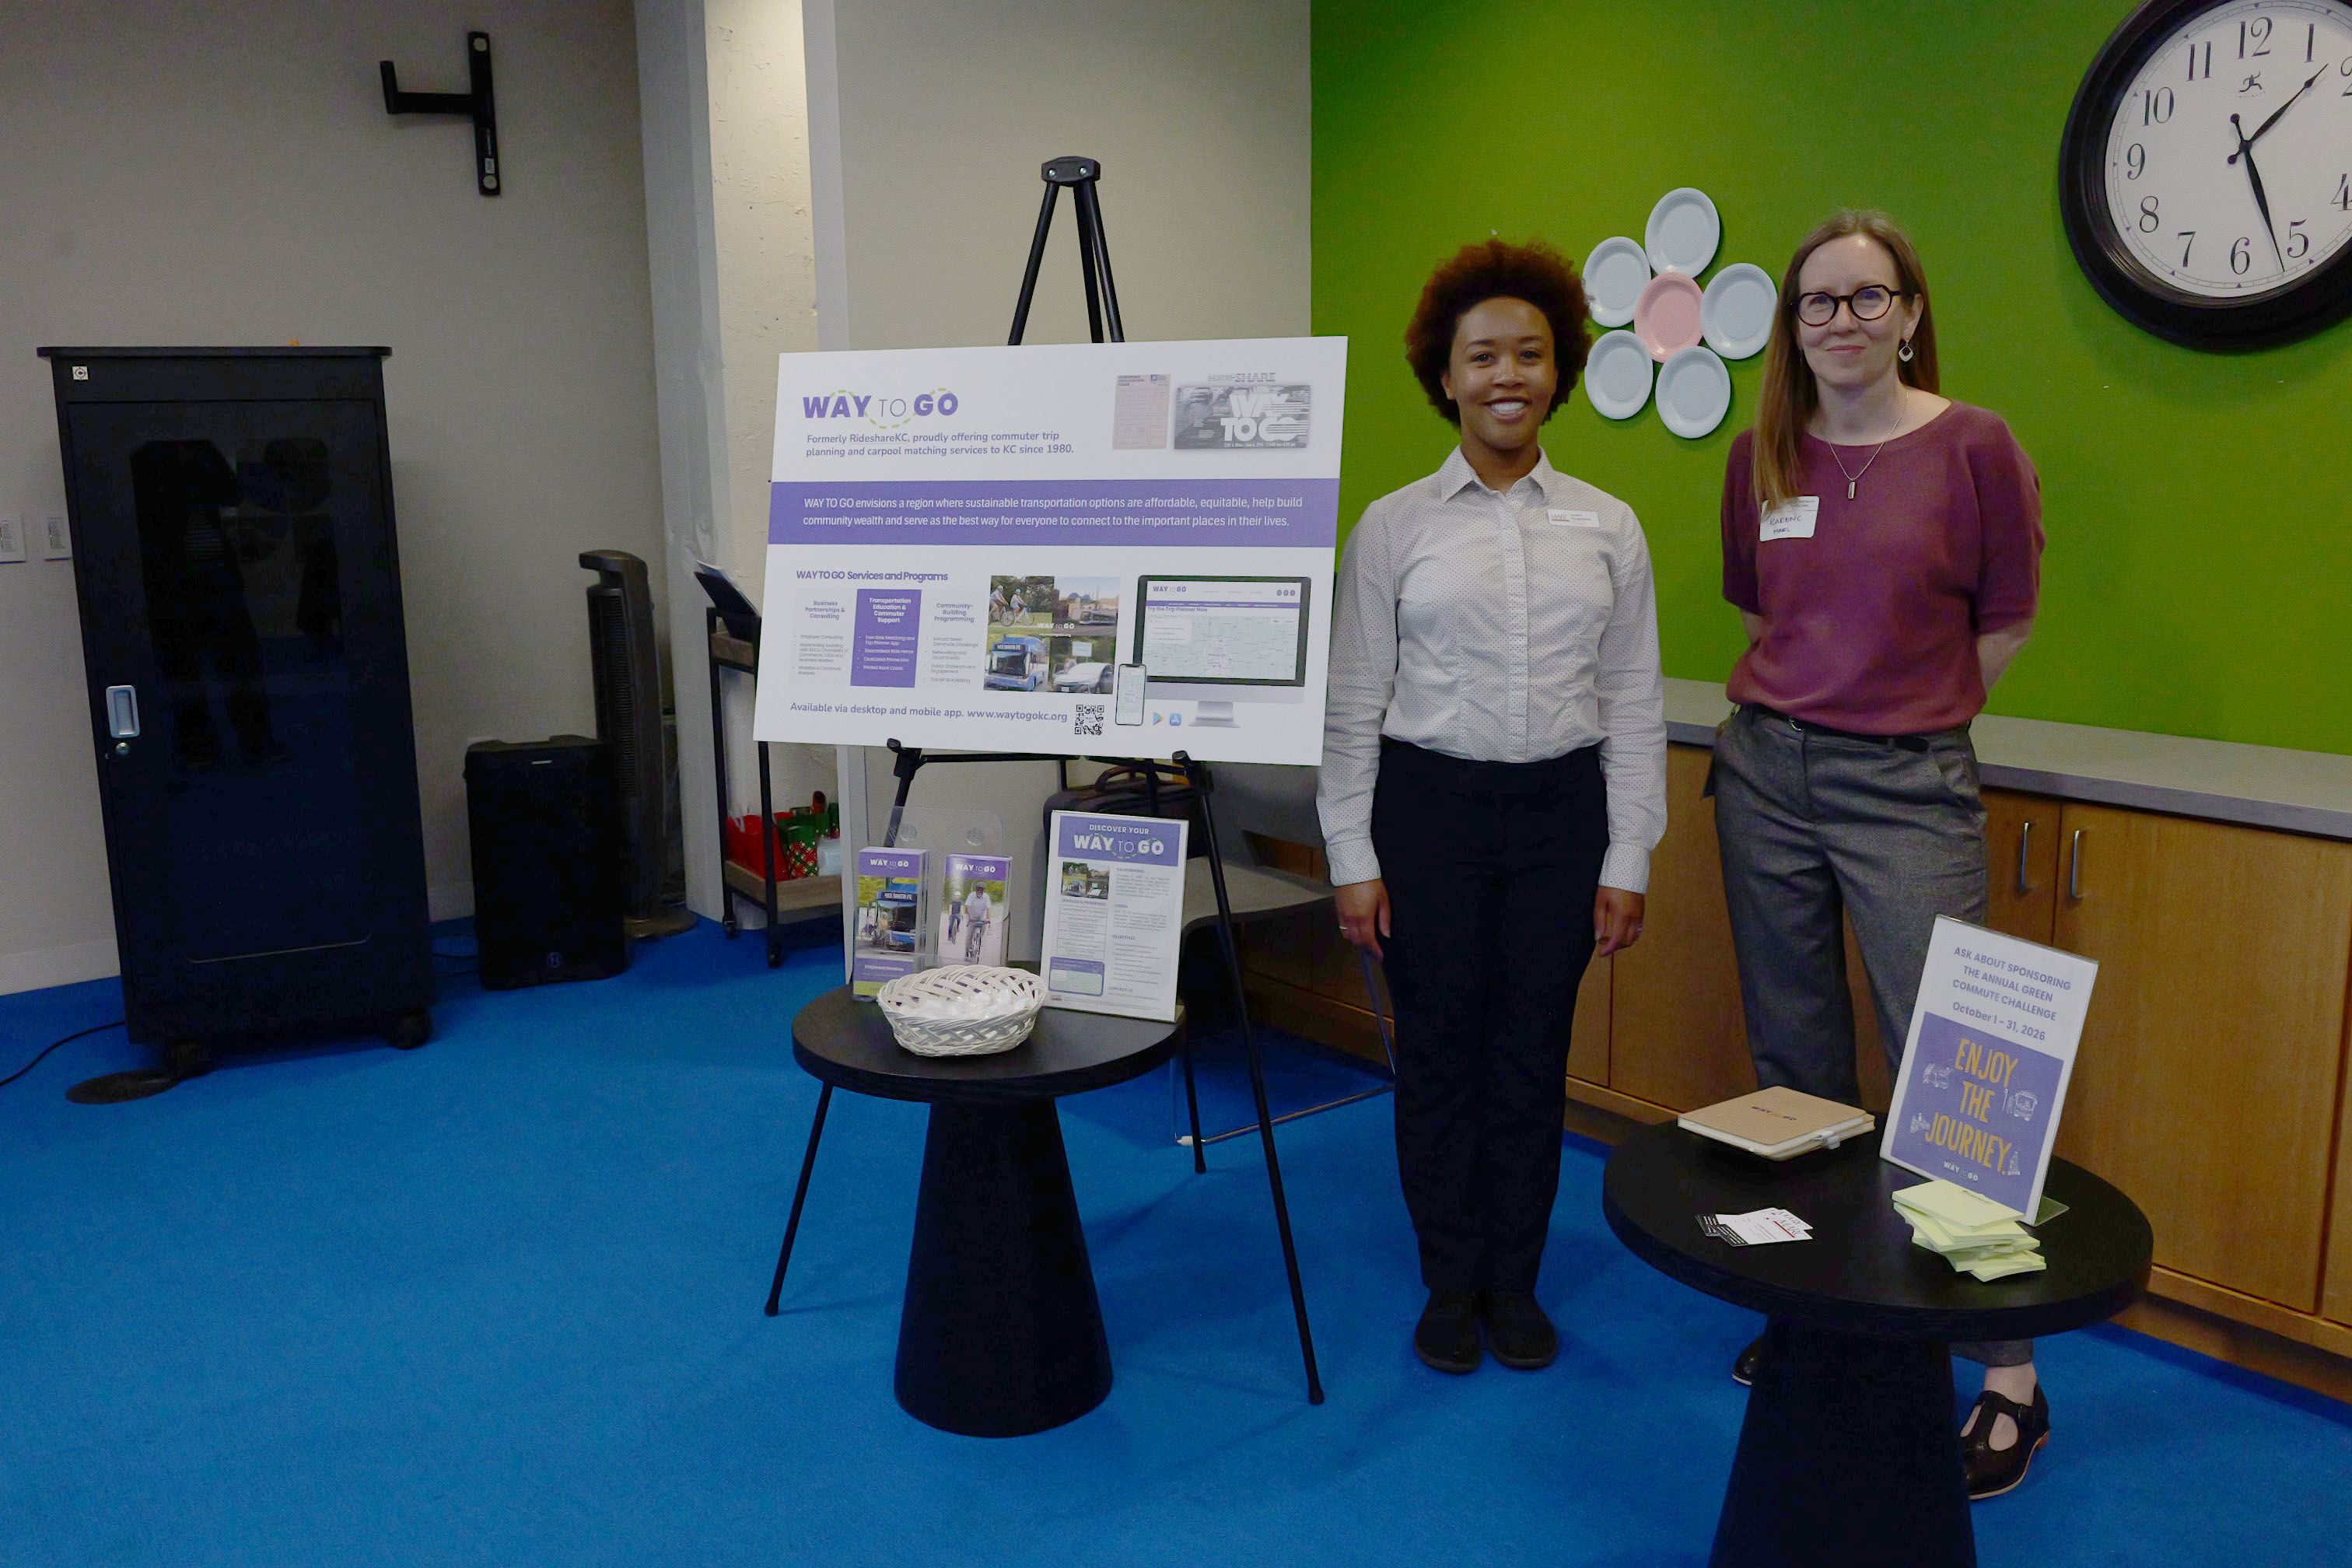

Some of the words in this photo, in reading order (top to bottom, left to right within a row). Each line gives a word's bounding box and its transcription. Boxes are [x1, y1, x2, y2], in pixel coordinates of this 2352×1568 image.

[2237, 16, 2273, 59] 12
[2302, 23, 2315, 62] 1
[2186, 41, 2212, 81] 11
[2142, 86, 2175, 126] 10
[2126, 143, 2145, 180] 9
[2330, 173, 2352, 212] 4
[2139, 196, 2159, 233] 8
[2178, 231, 2196, 268] 7
[2230, 237, 2250, 275] 6
[2286, 219, 2309, 257] 5
[803, 395, 872, 418] WAY
[879, 398, 907, 418] TO
[914, 393, 958, 416] GO
[807, 434, 847, 444] Formerly
[849, 432, 910, 443] RideshareKC,
[912, 432, 949, 443] proudly
[951, 432, 988, 443] offering
[991, 432, 1039, 441] commuter
[1042, 431, 1059, 441] trip
[1220, 417, 1258, 442] TO
[806, 446, 845, 457] planning
[848, 446, 864, 456] and
[867, 446, 901, 458] carpool
[905, 446, 947, 457] matching
[950, 445, 988, 454] services
[991, 446, 1000, 454] to
[1003, 445, 1017, 453] KC
[1019, 444, 1044, 453] since
[1047, 444, 1074, 453] 1980.
[804, 498, 824, 508] WAY
[825, 498, 837, 508] TO
[839, 498, 854, 508] GO
[856, 498, 897, 508] envisions
[906, 498, 934, 509] region
[935, 498, 964, 508] where
[965, 498, 1019, 508] sustainable
[1020, 498, 1087, 509] transportation
[1089, 498, 1125, 509] options
[1128, 499, 1143, 508] are
[1144, 497, 1198, 509] affordable,
[1200, 497, 1250, 509] equitable,
[1252, 497, 1275, 509] help
[1276, 496, 1303, 507] build
[803, 516, 852, 527] community
[854, 516, 884, 526] wealth
[885, 516, 902, 526] and
[904, 517, 928, 526] serve
[929, 517, 940, 526] as
[942, 516, 957, 526] the
[959, 516, 979, 526] best
[981, 517, 999, 527] way
[1001, 516, 1013, 526] for
[1015, 517, 1058, 527] everyone
[1059, 516, 1069, 526] to
[1071, 516, 1110, 526] connect
[1112, 516, 1122, 526] to
[1124, 516, 1139, 526] the
[1142, 516, 1190, 528] important
[1192, 516, 1225, 528] places
[1227, 516, 1237, 526] in
[1238, 516, 1262, 526] their
[1264, 516, 1290, 526] lives.
[796, 571, 818, 579] WAY
[818, 571, 831, 579] TO
[831, 571, 845, 579] GO
[847, 571, 884, 580] Services
[884, 572, 903, 580] and
[904, 572, 948, 583] Programs
[790, 702, 832, 712] Available
[835, 704, 848, 712] via
[850, 705, 887, 716] desktop
[889, 705, 907, 715] and
[909, 706, 941, 716] mobile
[943, 709, 964, 719] app.
[967, 710, 1068, 723] www.waytogokc.org
[1073, 834, 1115, 852] WAY
[1117, 840, 1135, 853] TO
[1137, 839, 1164, 856] GO
[1089, 824, 1127, 834] DISCOVER
[1129, 827, 1150, 835] YOUR
[983, 865, 996, 873] GO
[1954, 947, 1973, 960] ASK
[1973, 953, 2007, 970] ABOUT
[2007, 963, 2072, 990] SPONSORING
[1963, 965, 1981, 978] THE
[1981, 971, 2020, 992] ANNUAL
[2021, 985, 2053, 1002] GREEN
[1953, 978, 2000, 1002] COMMUTE
[2001, 995, 2057, 1021] CHALLENGE
[1953, 1001, 1992, 1022] October
[2006, 1020, 2018, 1033] 31,
[2021, 1024, 2046, 1041] 2026
[1955, 1038, 2018, 1089] ENJOY
[1959, 1080, 1996, 1124] THE
[1925, 1111, 2013, 1175] JOURNEY.
[1968, 1172, 1979, 1181] GO
